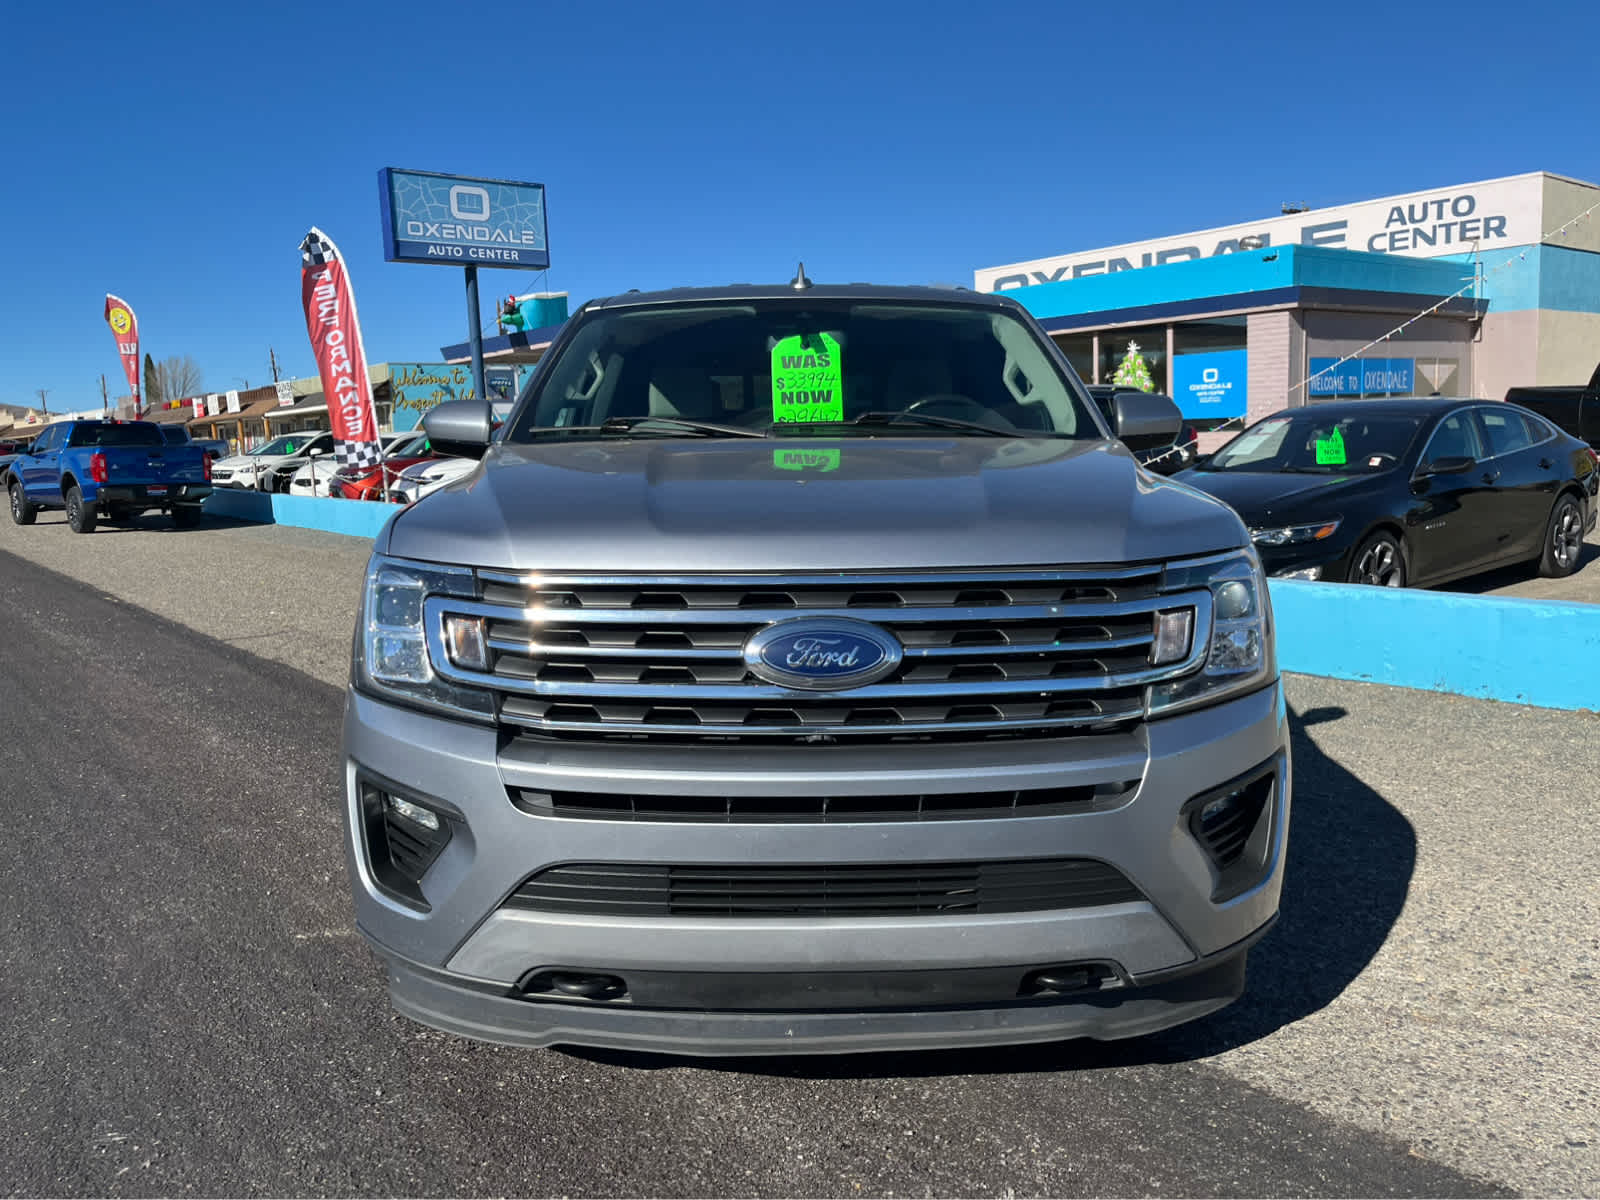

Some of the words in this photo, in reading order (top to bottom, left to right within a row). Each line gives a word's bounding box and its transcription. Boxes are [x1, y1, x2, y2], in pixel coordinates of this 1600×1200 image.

[1385, 194, 1476, 229] AUTO
[407, 220, 535, 245] OXENDALE
[1367, 215, 1508, 254] CENTER
[427, 245, 463, 257] AUTO
[469, 247, 519, 261] CENTER
[781, 353, 831, 369] WAS
[1311, 375, 1345, 392] WELCOME
[1349, 375, 1358, 390] TO
[1364, 370, 1408, 390] OXENDALE
[781, 389, 833, 406] NOW
[786, 637, 860, 668] Ford
